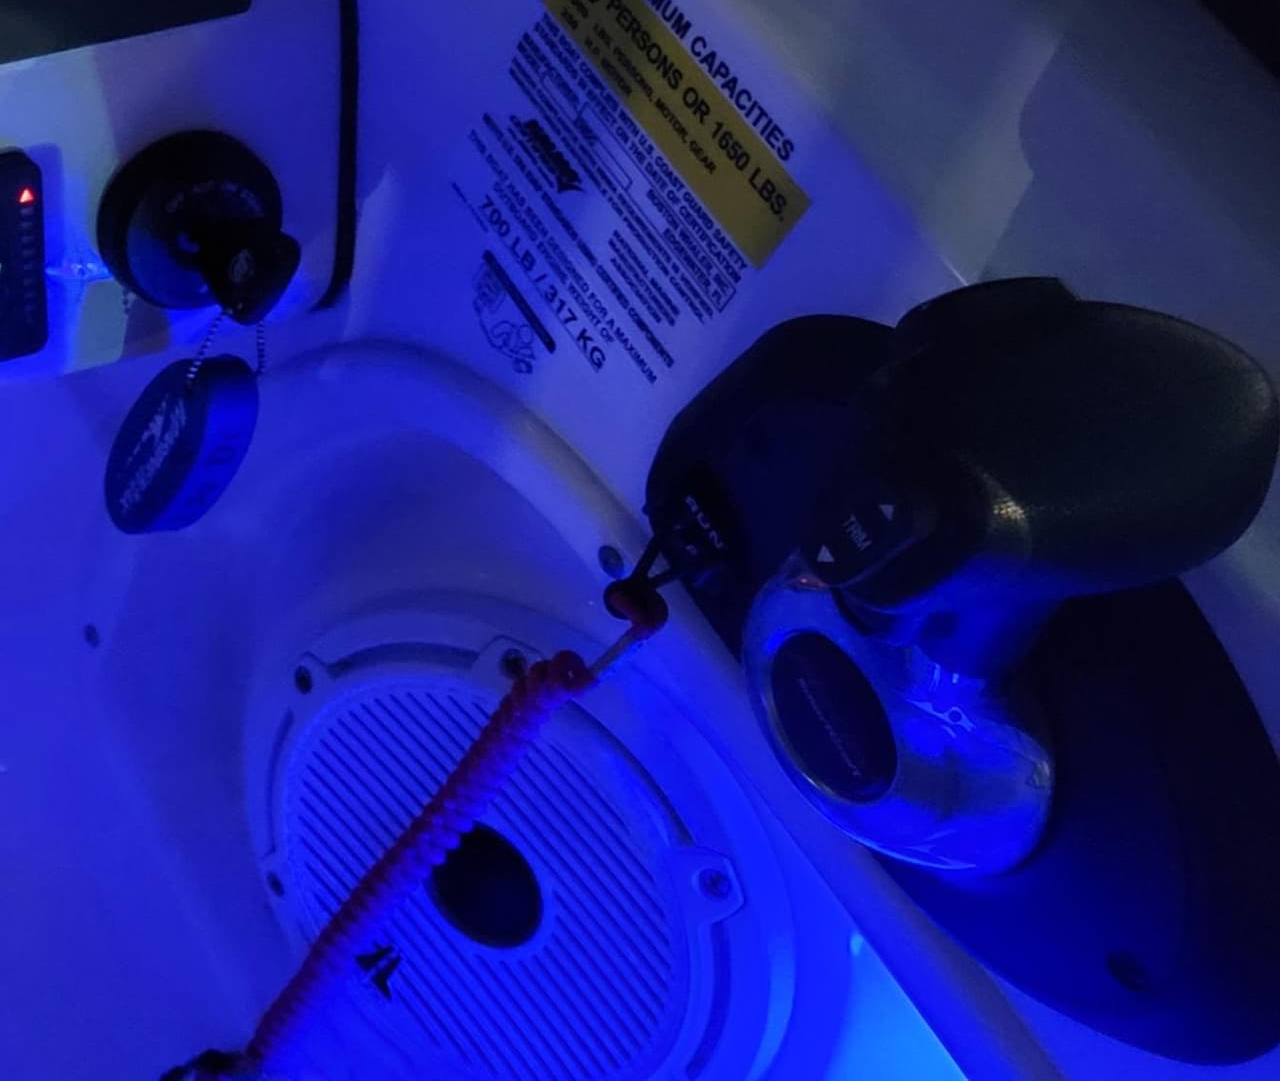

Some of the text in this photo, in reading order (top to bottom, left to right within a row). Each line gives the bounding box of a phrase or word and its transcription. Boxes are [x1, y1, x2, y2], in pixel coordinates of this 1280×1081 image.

[533, 19, 580, 81] STANDARDS
[585, 86, 617, 129] EFFECT
[614, 124, 629, 144] ON
[627, 140, 647, 166] THE
[643, 160, 668, 193] DATE
[665, 187, 680, 208] OF
[677, 203, 741, 285] CERTIFICATION
[541, 10, 560, 37] THIS
[578, 58, 620, 113] COMPLIES
[616, 107, 640, 138] WITH
[637, 132, 657, 159] U.S.
[653, 153, 685, 194] COAST
[681, 189, 714, 232] GUARD
[711, 226, 748, 273] SAFETY
[610, 44, 656, 103] PERSONS,
[653, 96, 691, 144] MOTOR,
[687, 137, 717, 175] GEAR
[679, 82, 713, 126] OR
[708, 118, 752, 173] 1650
[746, 165, 793, 222] LBS.
[687, 32, 798, 163] CAPACITIES
[479, 192, 512, 241] 700
[509, 234, 537, 276] LB
[543, 280, 578, 332] 317
[575, 324, 608, 372] KG
[506, 179, 526, 209] HAS
[523, 204, 548, 240] BEEN
[546, 233, 589, 296] DESIGNED
[587, 289, 609, 320] FOR
[612, 323, 657, 387] MAXIMUM
[646, 187, 731, 297] BOSTON WHALER, INC.
[662, 226, 723, 306] EDGEWATER, FL
[566, 279, 601, 329] WEIGHT
[598, 324, 615, 348] OF
[595, 262, 630, 311] CERTIFIED
[627, 304, 674, 370] COMPONENTS
[841, 514, 872, 551] TRIM
